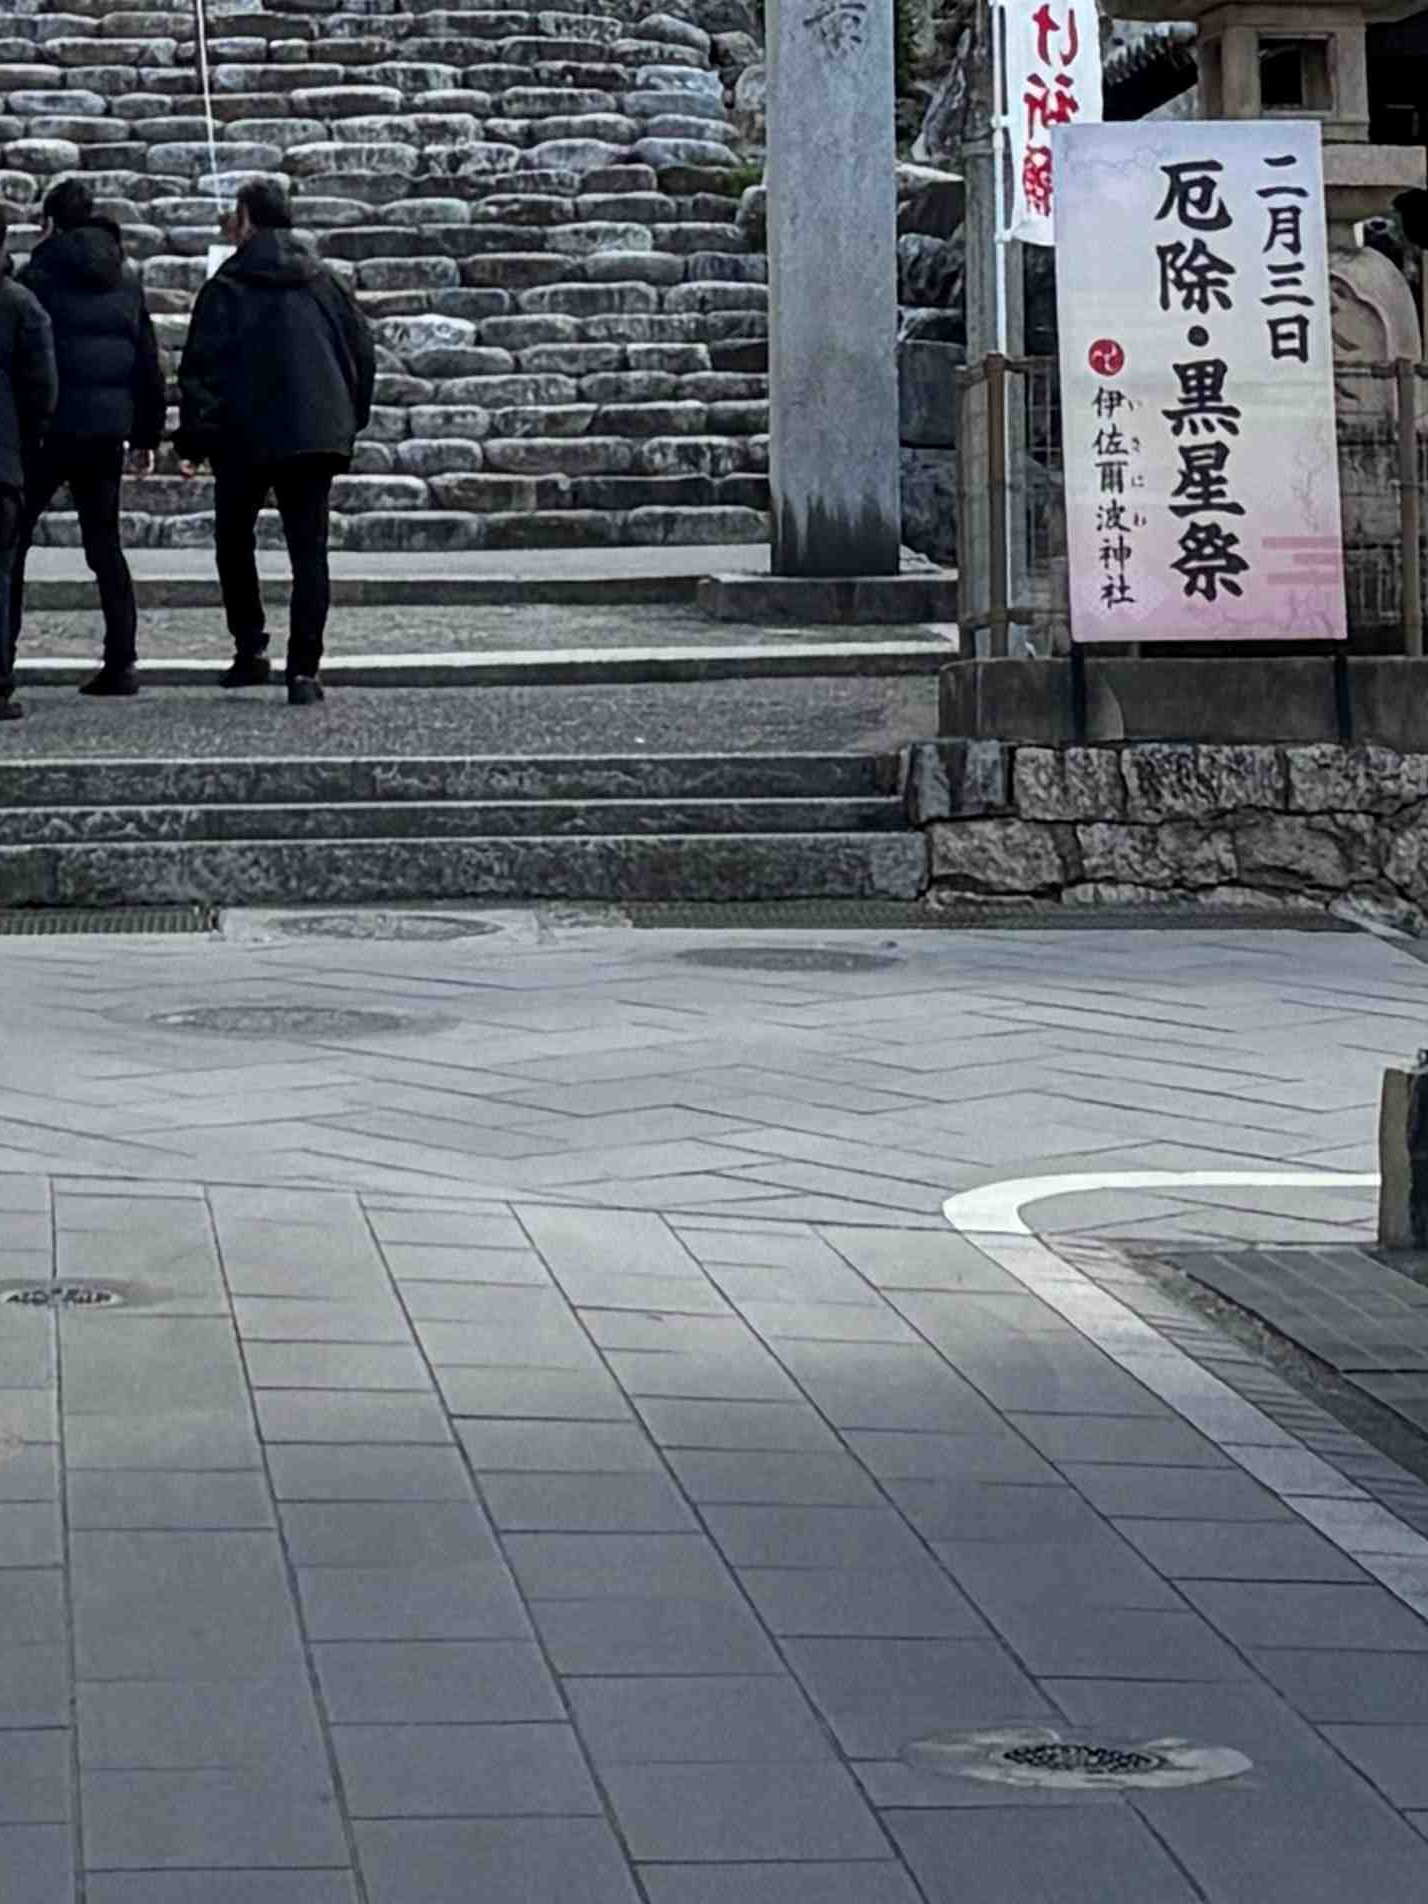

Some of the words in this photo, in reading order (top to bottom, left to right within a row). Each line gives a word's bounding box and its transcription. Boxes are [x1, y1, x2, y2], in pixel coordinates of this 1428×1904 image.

[1256, 155, 1315, 364] 二月三日
[1092, 386, 1135, 609] 伊佐爾波神社
